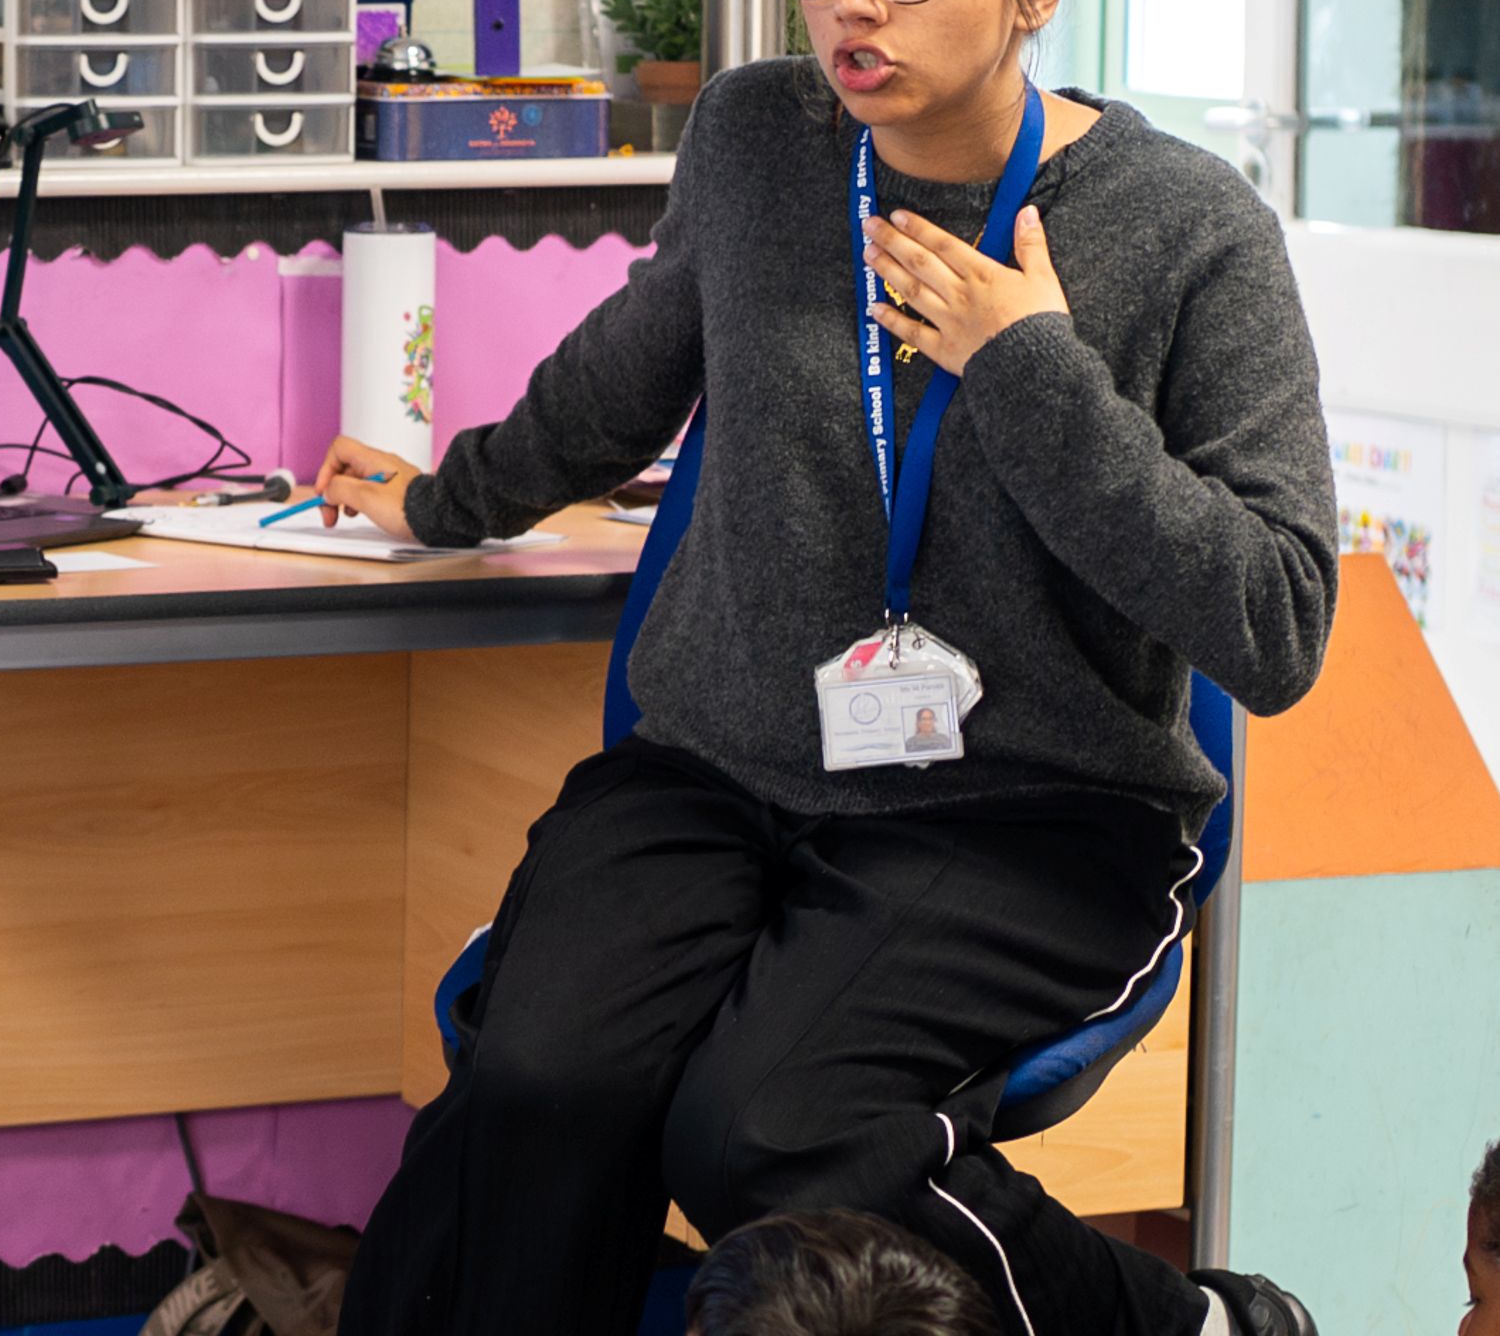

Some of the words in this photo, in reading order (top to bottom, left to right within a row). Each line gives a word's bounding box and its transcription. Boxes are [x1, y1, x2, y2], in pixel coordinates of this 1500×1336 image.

[856, 145, 868, 188] Strive
[865, 323, 881, 355] kind
[867, 355, 882, 377] Be
[867, 386, 885, 436] School
